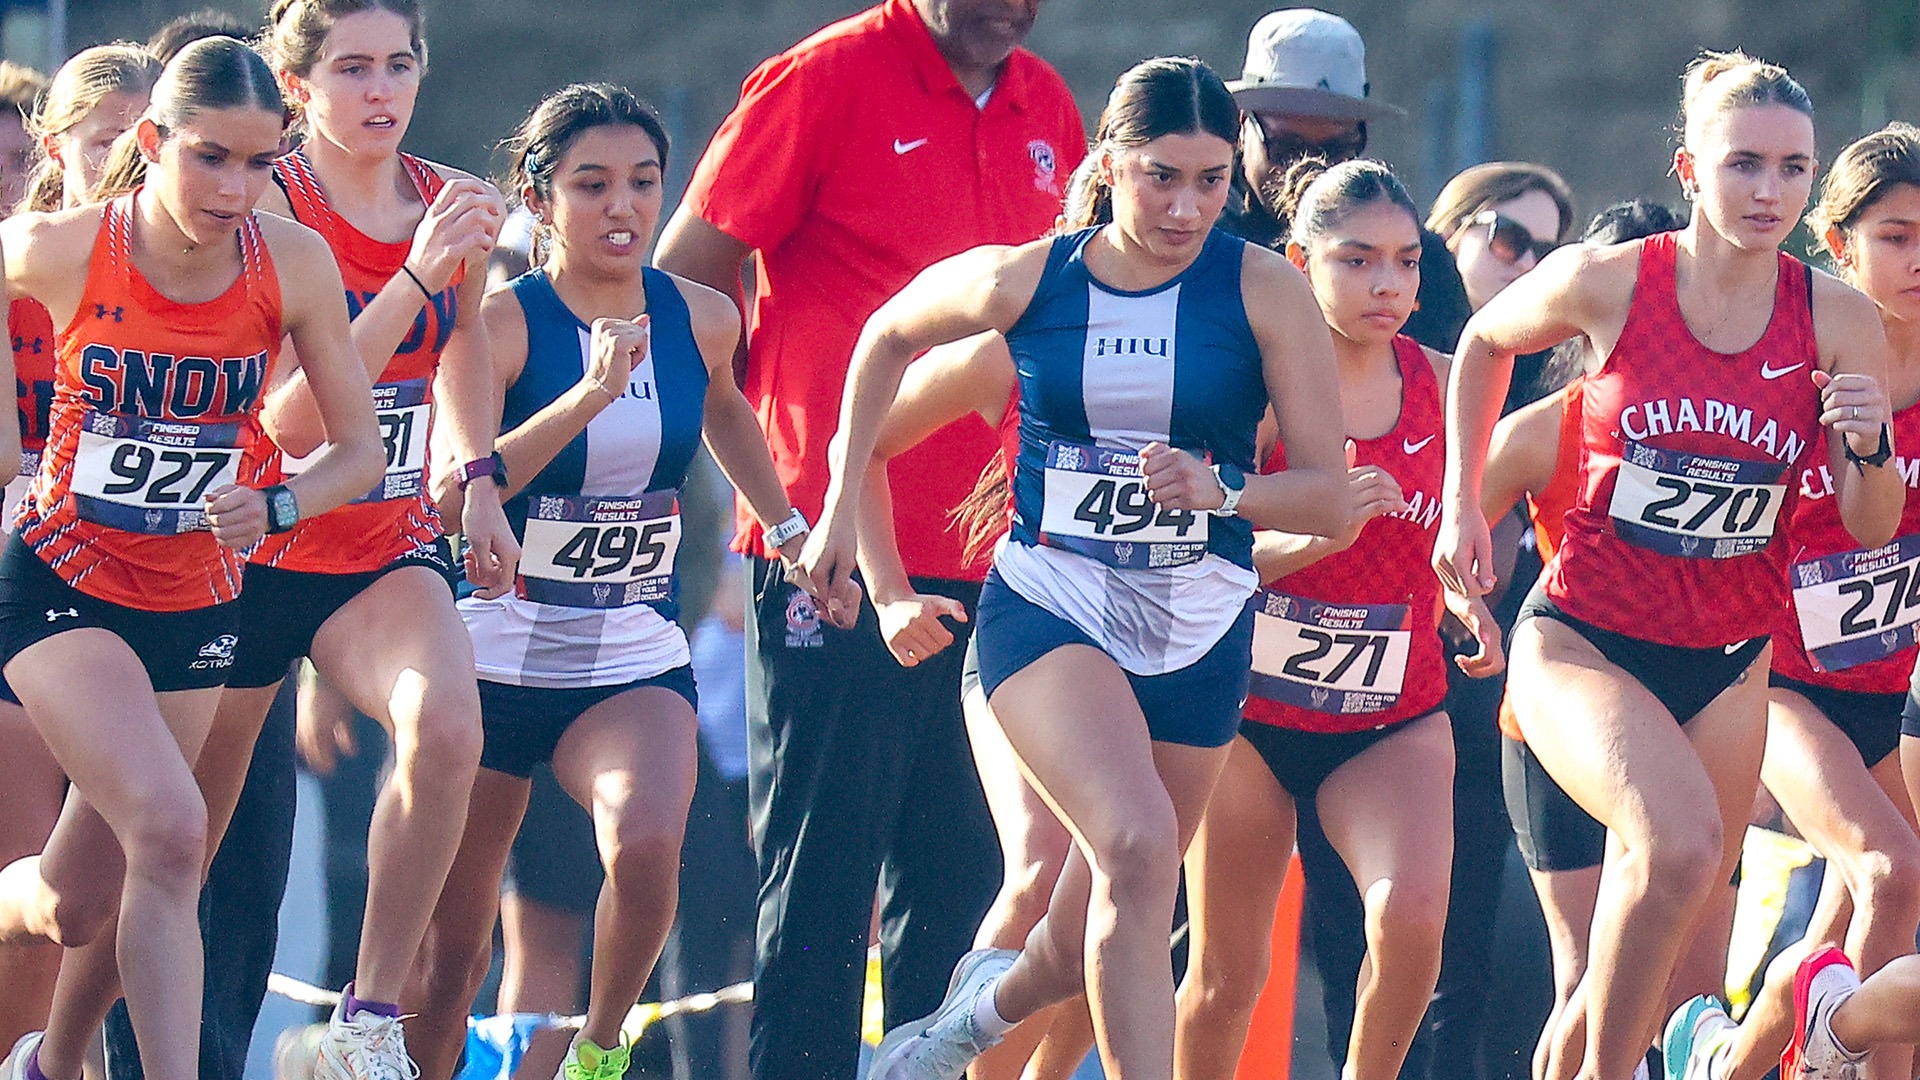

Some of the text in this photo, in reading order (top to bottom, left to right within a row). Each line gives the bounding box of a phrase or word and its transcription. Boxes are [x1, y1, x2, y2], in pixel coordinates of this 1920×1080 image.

[1093, 338, 1168, 357] HIU
[80, 343, 268, 419] SNOW
[371, 387, 397, 397] ISHED
[374, 400, 395, 409] ULTS
[152, 423, 200, 435] FINISHED
[1620, 397, 1807, 466] CHAPMAN
[147, 434, 197, 447] RESULTS
[378, 410, 414, 467] 31
[1111, 453, 1140, 465] FINIS
[1691, 457, 1740, 473] FINISHED
[103, 443, 231, 504] 927
[1108, 465, 1144, 477] RESUL
[1686, 467, 1736, 482] RESULTS
[596, 499, 642, 512] FINISHED
[1074, 479, 1196, 537] 494
[1640, 476, 1771, 534] 270
[593, 510, 638, 523] RESULTS
[552, 521, 672, 578] 495
[1855, 541, 1900, 564] FINISHED
[1854, 555, 1900, 575] RESULTS
[1323, 606, 1368, 619] FINISHED
[1318, 618, 1364, 630] RESULTS
[1282, 628, 1389, 687] 271
